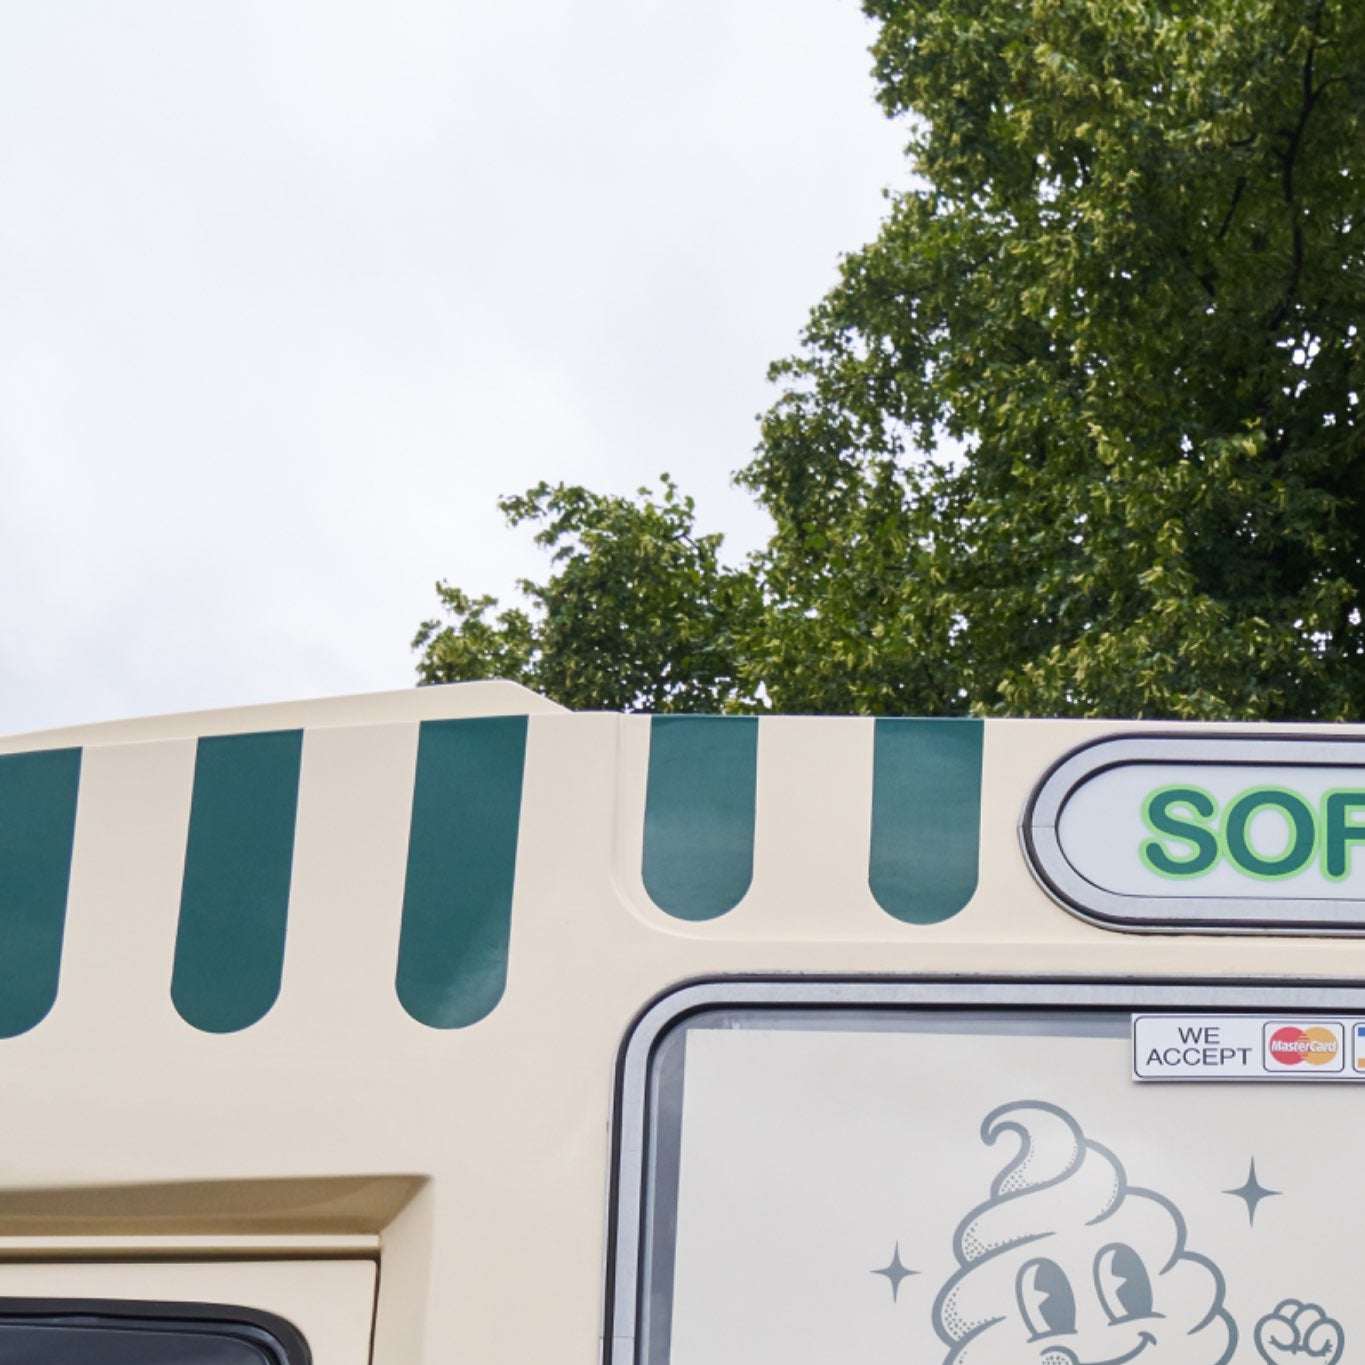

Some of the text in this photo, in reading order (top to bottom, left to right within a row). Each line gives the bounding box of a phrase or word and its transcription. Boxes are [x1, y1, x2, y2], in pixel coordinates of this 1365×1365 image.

[1178, 1026, 1221, 1046] WE
[1270, 1038, 1338, 1054] MasterCard
[1146, 1047, 1253, 1067] ACCEPT
